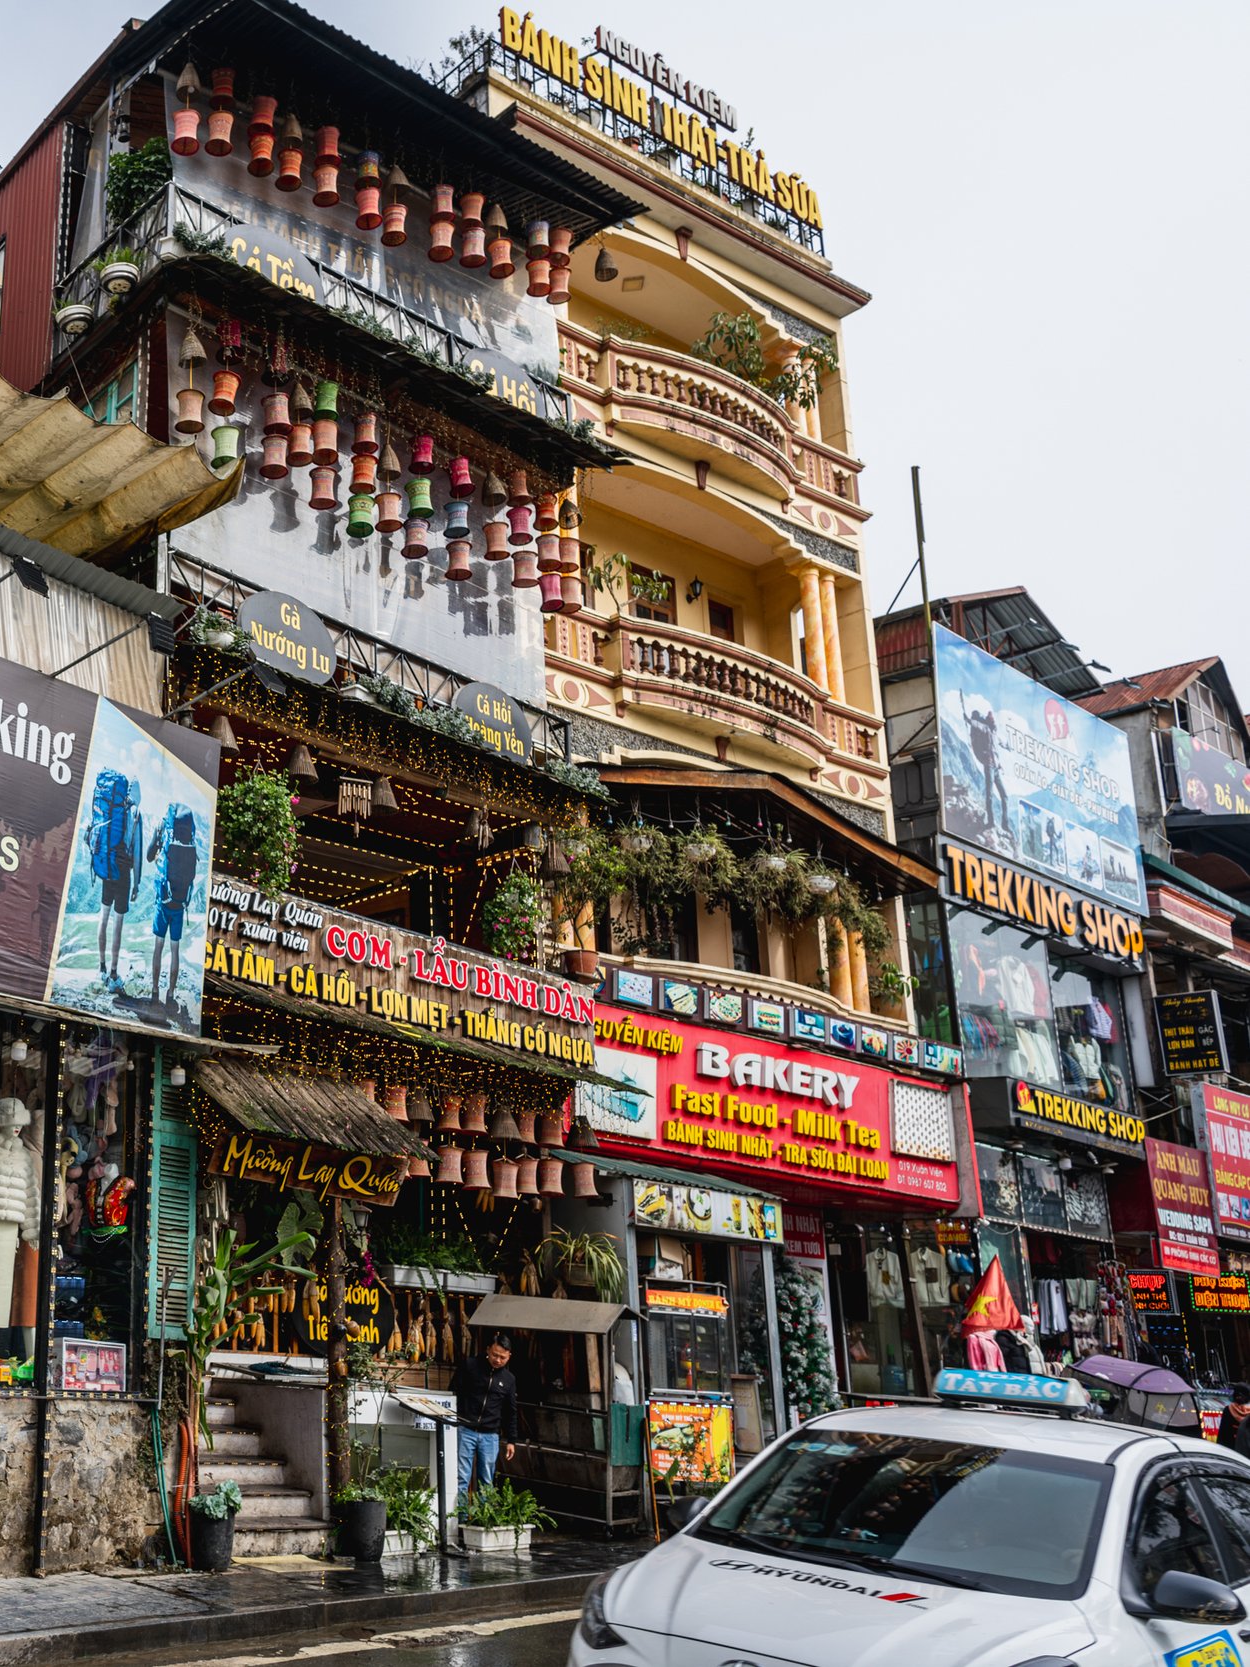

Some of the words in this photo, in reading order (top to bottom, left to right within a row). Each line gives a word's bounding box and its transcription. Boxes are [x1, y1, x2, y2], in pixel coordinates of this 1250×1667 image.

[499, 6, 580, 88] BÁNH
[582, 56, 649, 128] SINH
[266, 253, 316, 300] Tầm
[502, 375, 536, 415] Hồi
[280, 602, 301, 631] Gà
[251, 620, 307, 670] Nướng
[312, 646, 330, 675] Lu
[477, 693, 490, 716] Cá
[493, 697, 512, 725] Hồi
[504, 728, 525, 757] Yến
[1006, 724, 1081, 783] TREKKING
[1082, 766, 1120, 800] SHOP
[210, 881, 250, 911] ường
[255, 892, 280, 920] Lay
[284, 901, 323, 928] Quán
[947, 845, 1077, 936] TREKKING
[1081, 900, 1144, 962] SHOP
[208, 908, 238, 931] 017
[243, 921, 277, 942] xuân
[282, 930, 309, 952] viên
[325, 924, 392, 971] CƠM
[414, 936, 469, 990] LẨU
[474, 962, 540, 1011] BÌNH
[543, 982, 594, 1026] DÂN
[291, 963, 319, 998] CÁ
[322, 970, 356, 1007] HỒI
[371, 986, 408, 1021] LỢN
[411, 996, 449, 1032] MẸT
[465, 1007, 521, 1049] THẮNG
[523, 1022, 546, 1053] CỐ
[549, 1032, 594, 1067] NGỰA
[594, 1015, 645, 1046] GUYỄN
[647, 1029, 683, 1056] KIỆM
[697, 1042, 860, 1109] BAKERY
[673, 1084, 720, 1118] Fast
[725, 1094, 778, 1129] Food
[795, 1109, 841, 1141] Milk
[846, 1120, 880, 1150] Tea
[1035, 1090, 1107, 1134] TREKKING
[1108, 1111, 1145, 1143] SHOP
[223, 1135, 295, 1193] Mường
[297, 1145, 336, 1201] Lay
[338, 1155, 401, 1196] Quán
[666, 1118, 703, 1146] BÁNH
[707, 1130, 738, 1152] SINH
[859, 1158, 889, 1180] LOAN
[1153, 1177, 1188, 1202] QUANG
[1189, 1185, 1210, 1207] HUY
[1157, 1207, 1193, 1231] WEDDING
[1193, 1215, 1214, 1235] SAPA
[344, 1280, 379, 1315] ướng
[1128, 1275, 1165, 1291] CHỤP
[1134, 1292, 1150, 1300] NH
[944, 1373, 999, 1394] TÂY
[1003, 1378, 1064, 1398] BẮC
[753, 1566, 883, 1598] HYUNDAI
